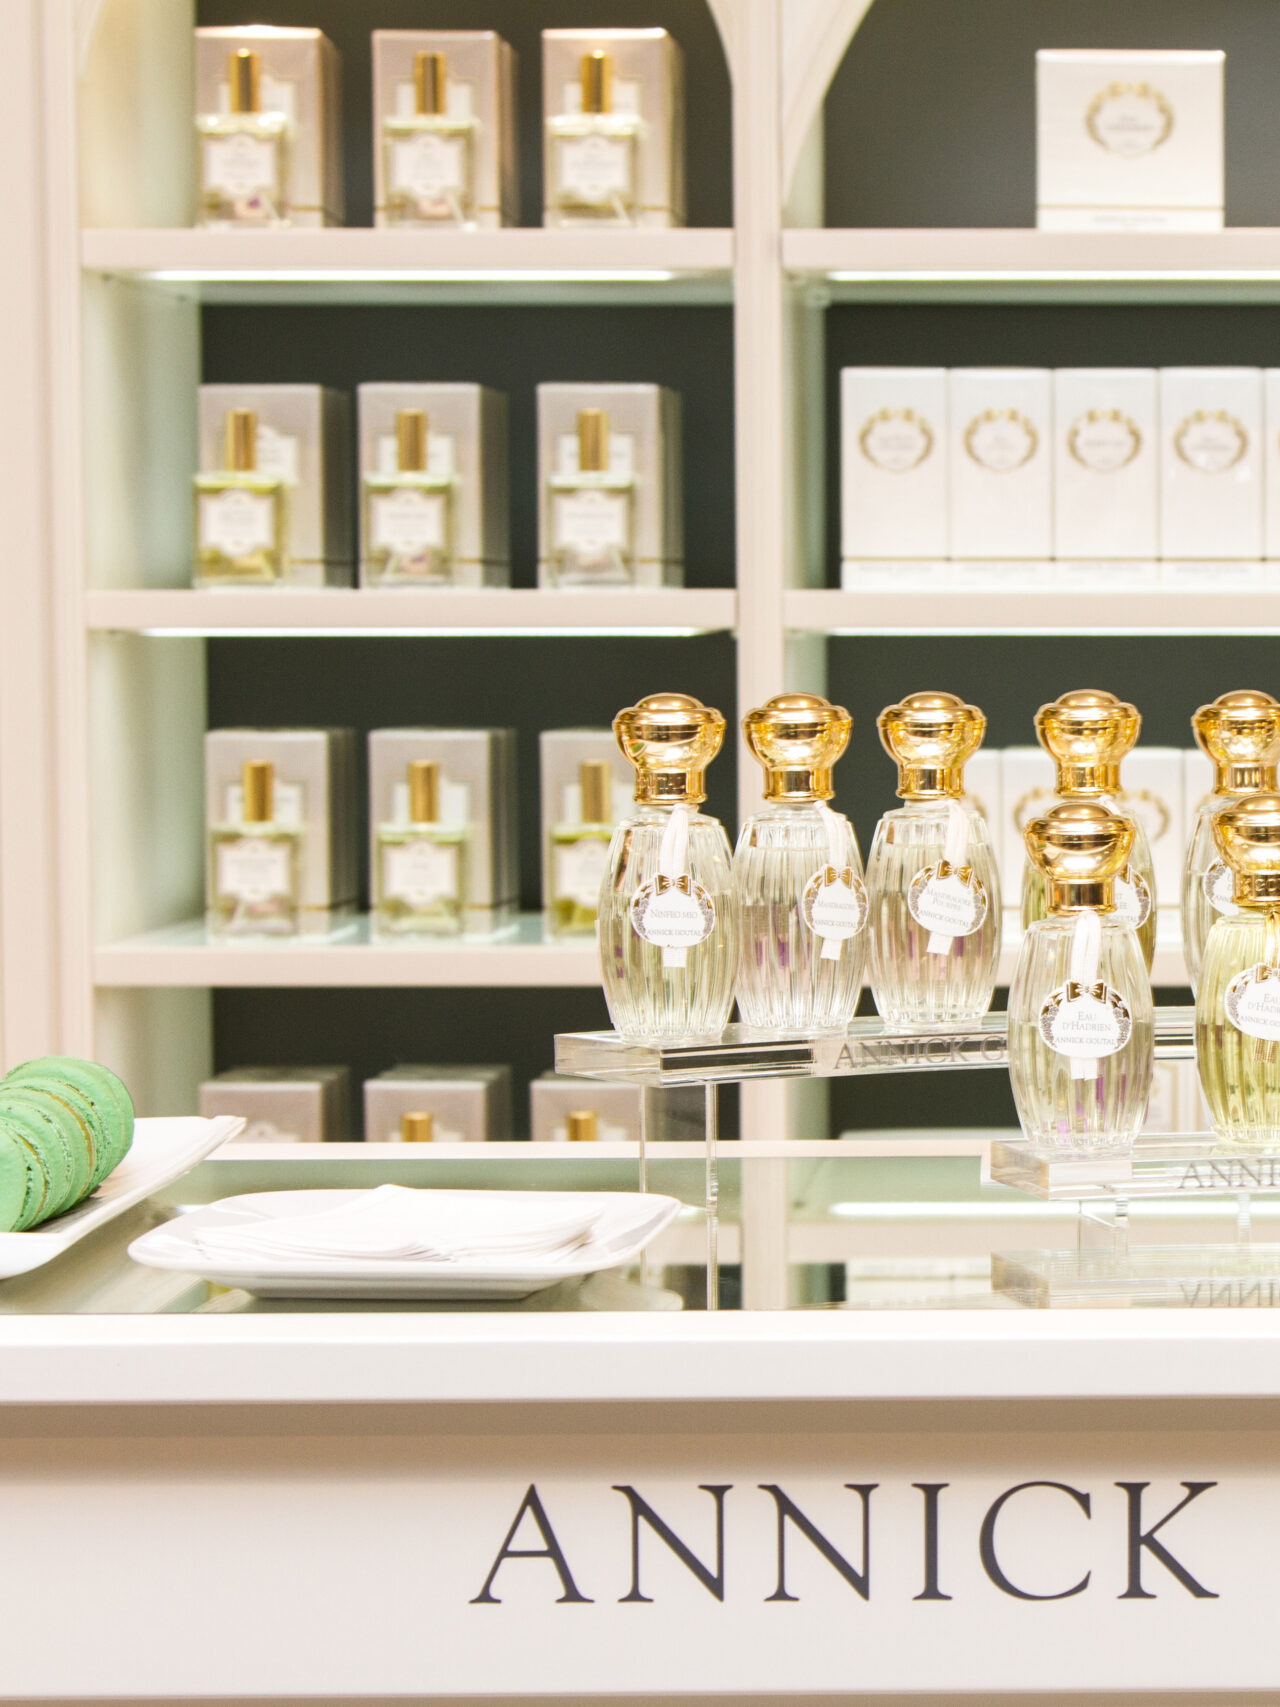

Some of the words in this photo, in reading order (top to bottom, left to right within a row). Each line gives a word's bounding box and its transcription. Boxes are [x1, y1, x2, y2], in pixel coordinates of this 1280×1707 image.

[815, 919, 834, 927] ANNICK
[835, 920, 857, 928] GOUTAL
[920, 909, 944, 920] ANNICK
[944, 915, 970, 928] GOUTAL
[646, 929, 673, 937] ANNICK
[674, 929, 703, 937] GOUTAL
[1078, 1010, 1098, 1021] EAU
[1240, 1015, 1269, 1025] ANNICK
[1055, 1036, 1084, 1044] ANNICK
[1085, 1036, 1117, 1046] GOUTAL
[832, 1037, 971, 1070] ANNICK
[469, 1480, 1221, 1604] ANNICK
